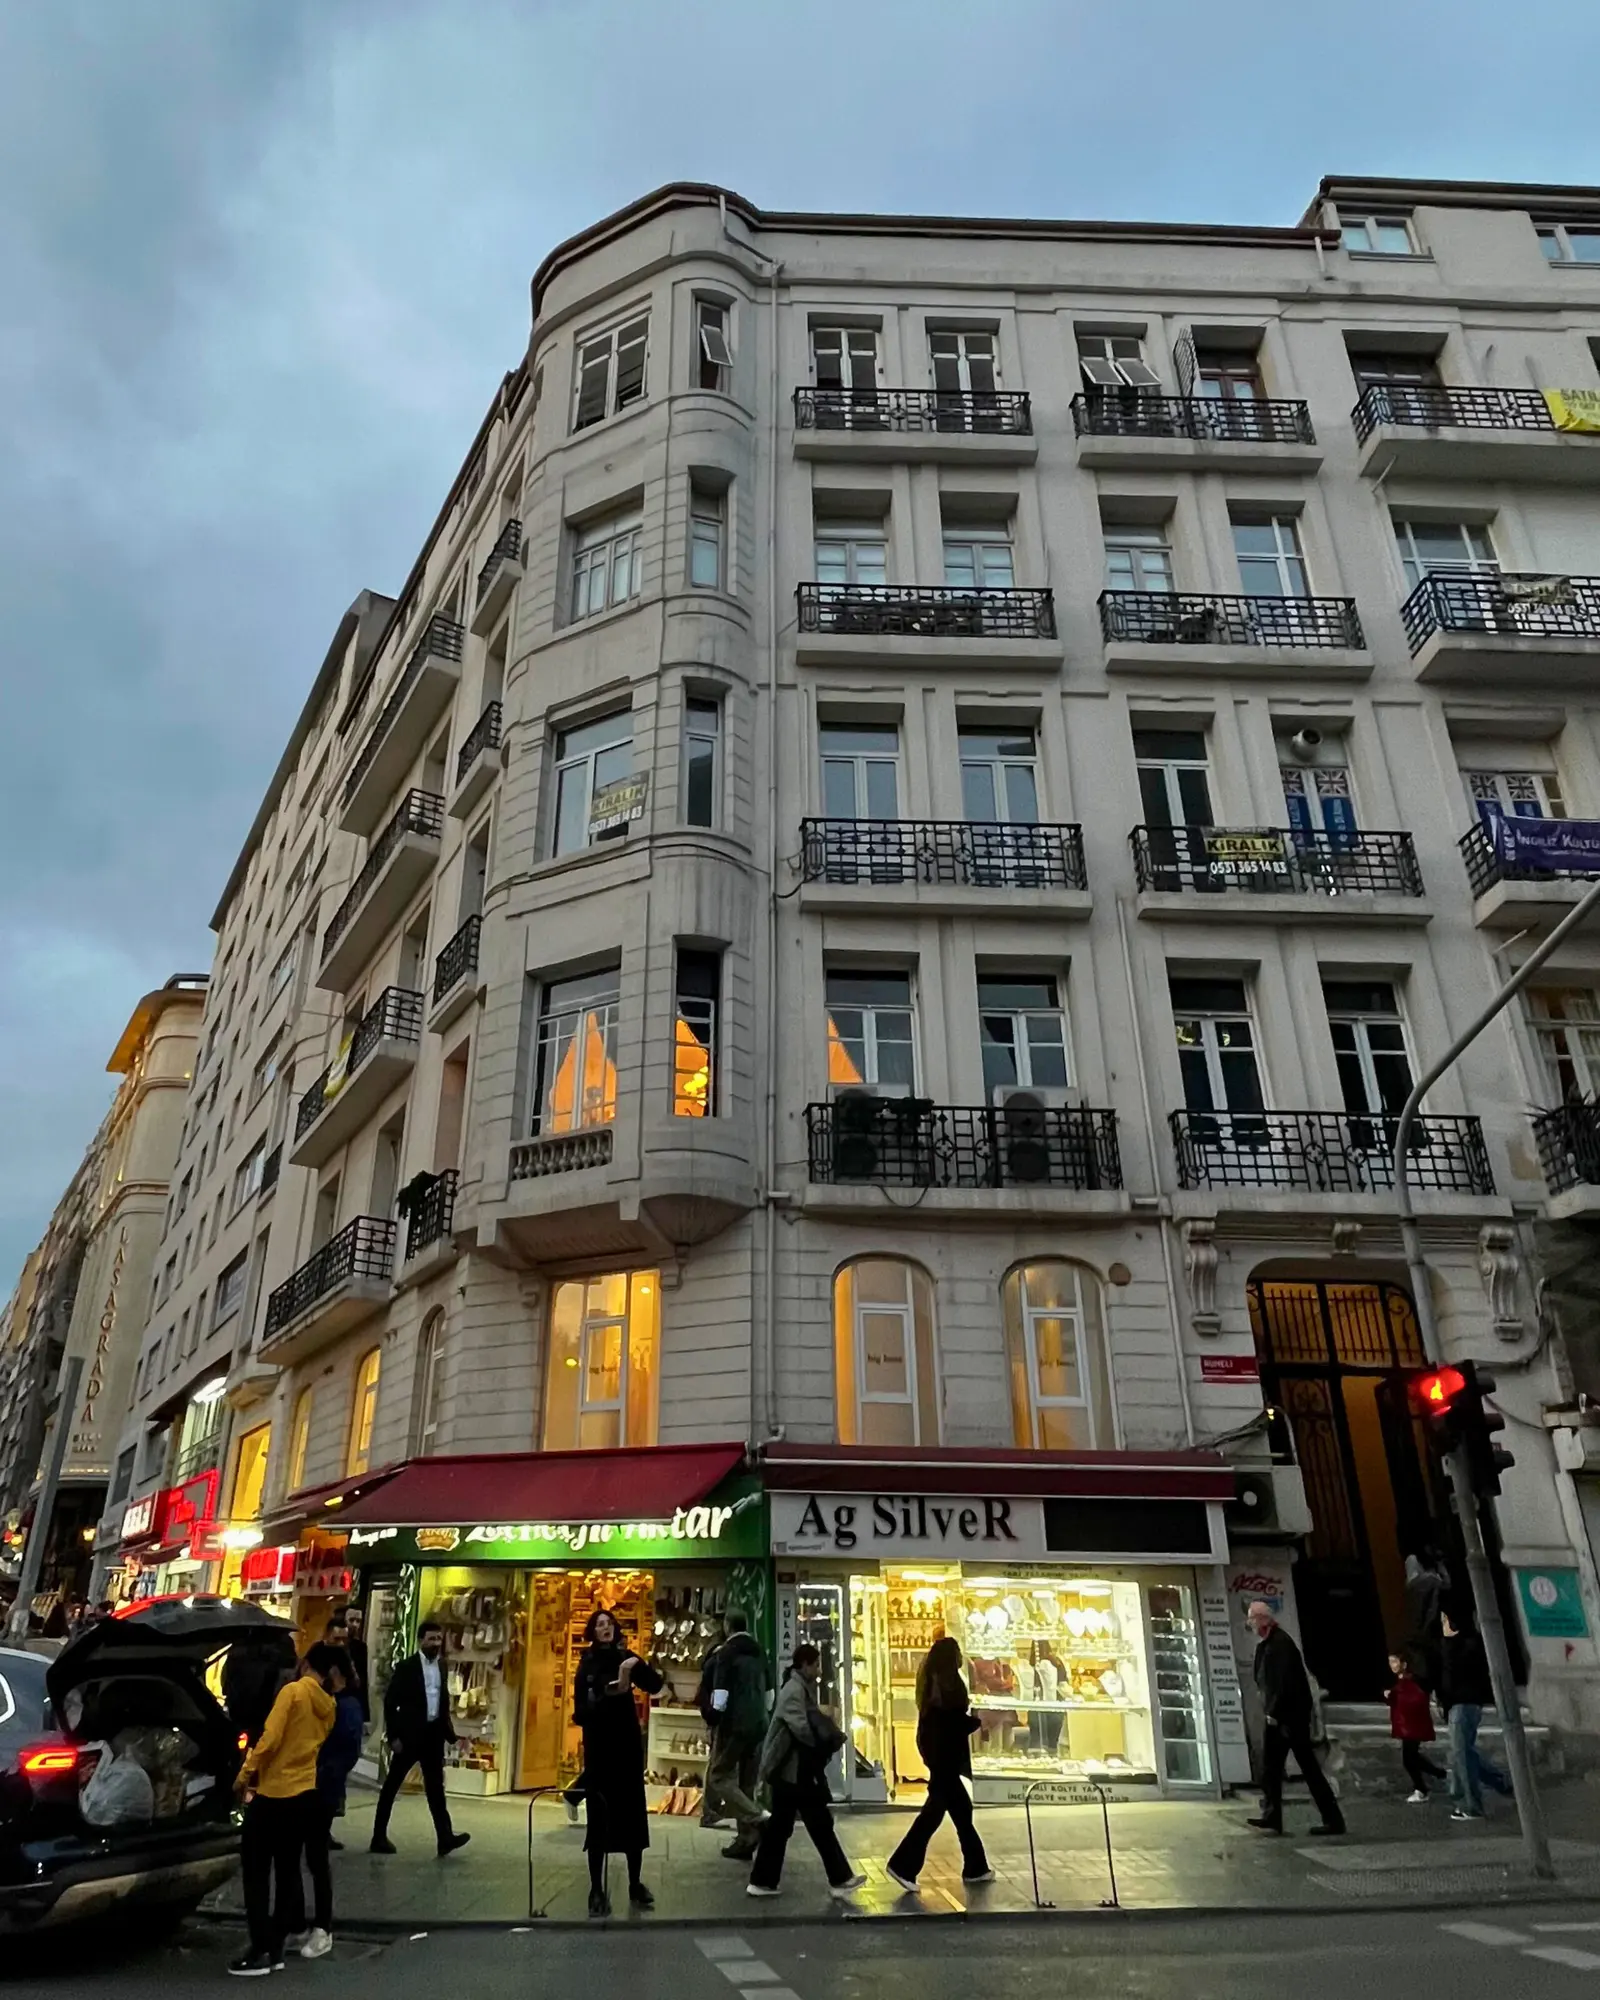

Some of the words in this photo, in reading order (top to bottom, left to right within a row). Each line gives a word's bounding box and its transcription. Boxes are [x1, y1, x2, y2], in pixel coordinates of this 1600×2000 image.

[1207, 839, 1281, 852] KİRALIK
[1210, 861, 1236, 874] 0531
[1238, 861, 1259, 874] 365
[1259, 861, 1272, 873] 14
[1272, 861, 1287, 874] 83
[795, 1496, 857, 1549] Ag
[872, 1495, 1018, 1542] SilveR
[782, 1600, 792, 1650] KULAK
